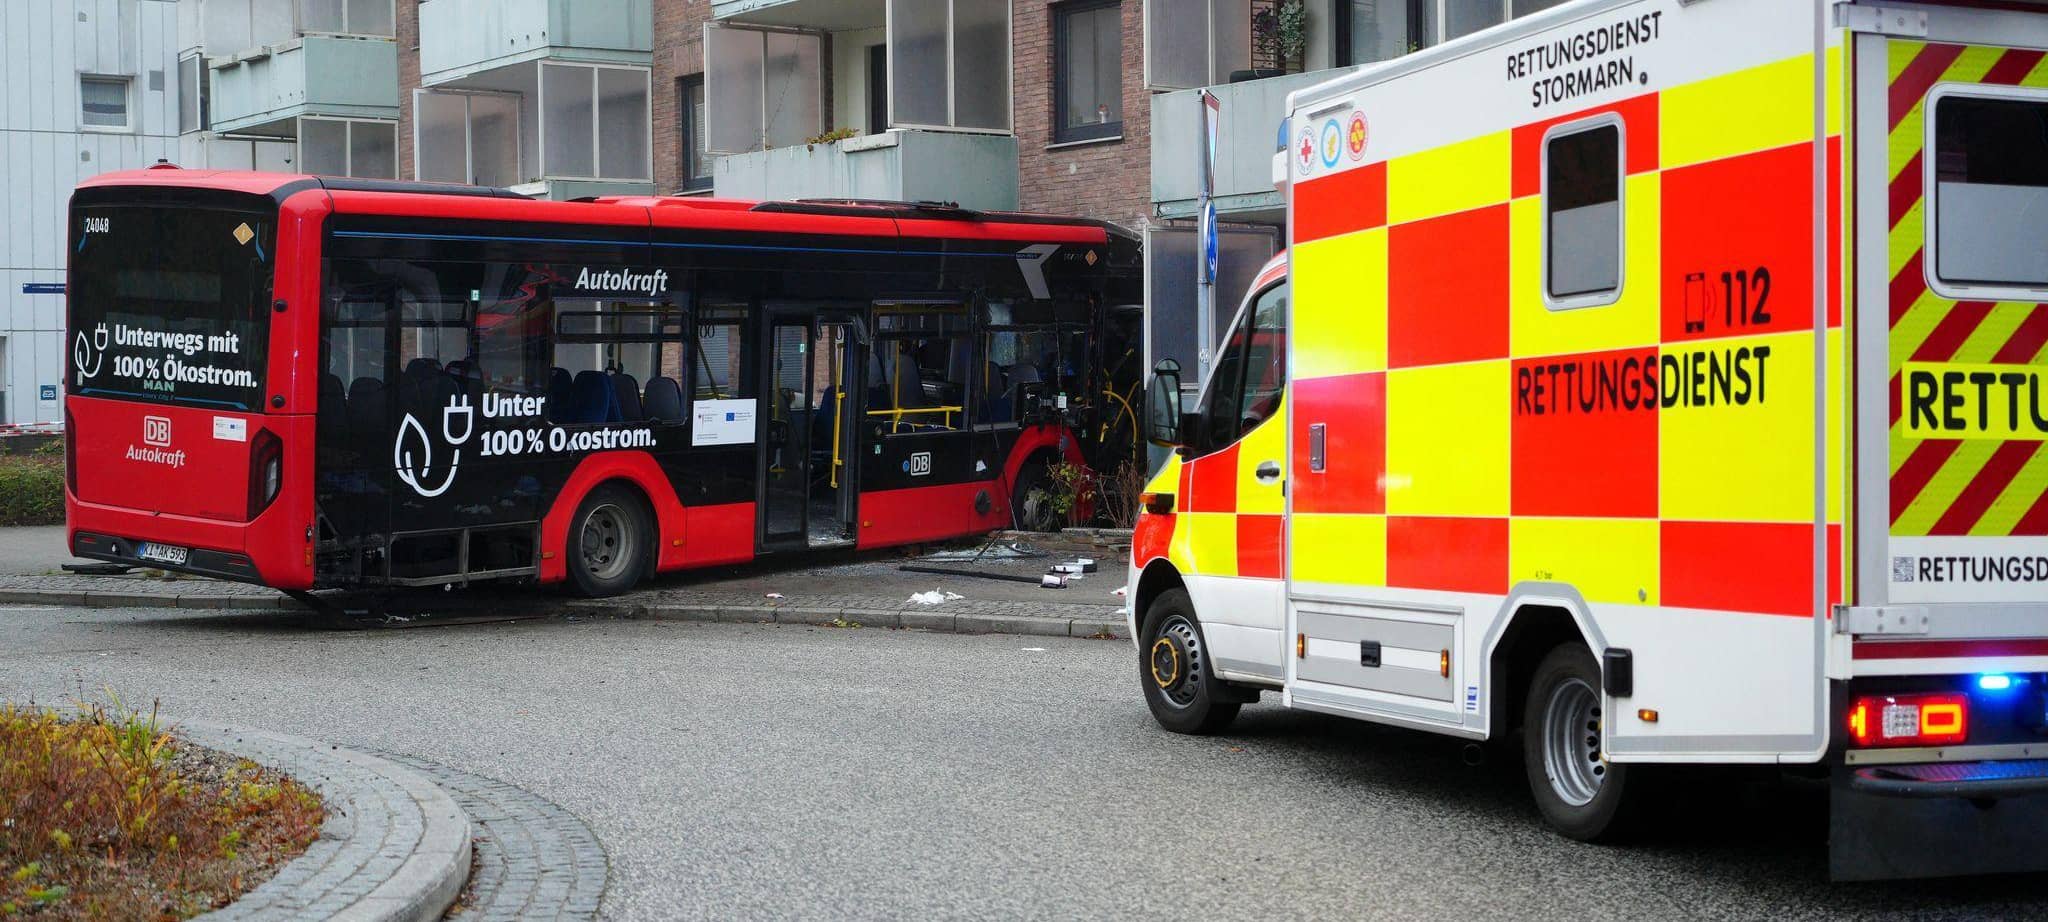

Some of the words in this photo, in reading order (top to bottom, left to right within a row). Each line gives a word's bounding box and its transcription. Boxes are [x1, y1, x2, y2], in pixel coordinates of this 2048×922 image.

[1507, 11, 1662, 80] RETTUNGSDIENST
[1532, 56, 1633, 108] STORMARN
[86, 217, 110, 233] 24048
[574, 266, 668, 297] Autokraft
[1720, 265, 1772, 328] 112
[115, 324, 204, 356] Unterwegs
[208, 330, 240, 354] mit
[163, 353, 258, 388] Ökostrom.
[1518, 345, 1771, 416] RETTUNGSDIENST
[143, 379, 175, 392] MAN
[482, 392, 546, 418] Unter
[146, 419, 168, 442] DB
[125, 444, 186, 469] Autokraft
[912, 454, 929, 473] DB
[170, 547, 186, 561] 593
[1919, 556, 2048, 582] RETTUNGSD
